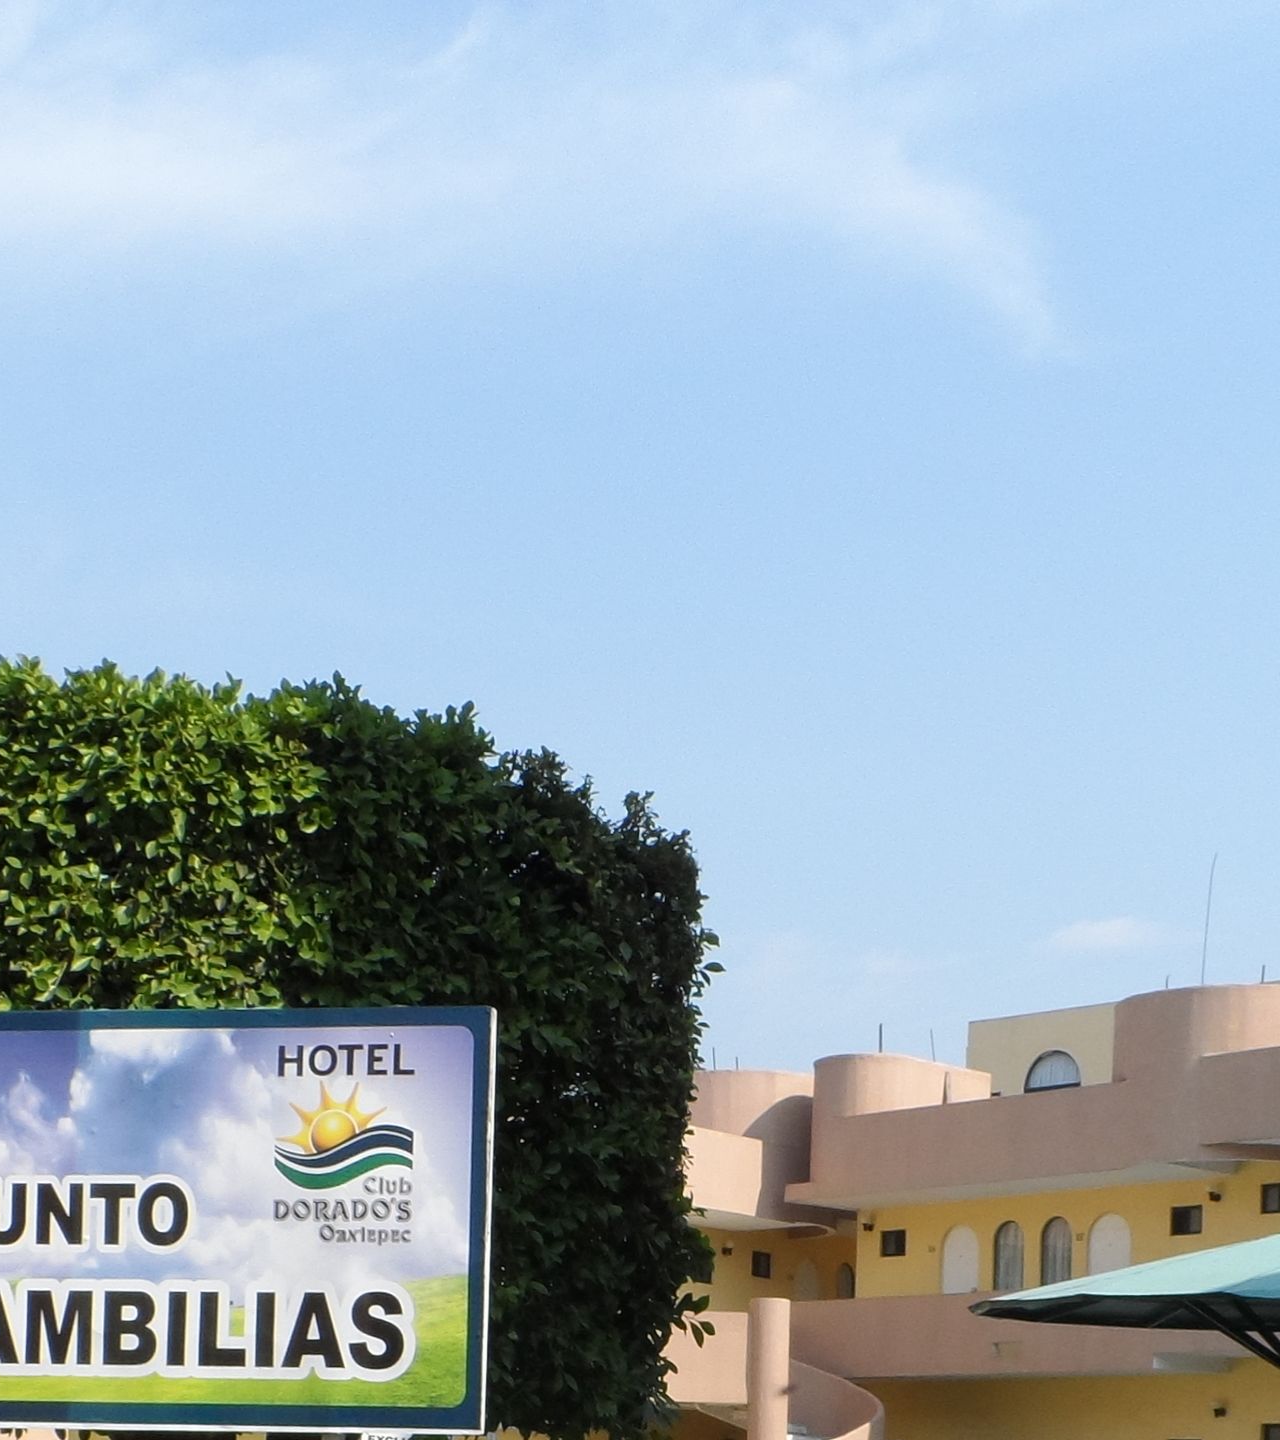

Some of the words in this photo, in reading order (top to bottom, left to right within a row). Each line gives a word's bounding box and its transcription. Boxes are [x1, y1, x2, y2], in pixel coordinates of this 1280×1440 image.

[277, 1043, 415, 1077] HOTEL
[363, 1176, 412, 1195] Club
[273, 1198, 412, 1222] DORADO'S
